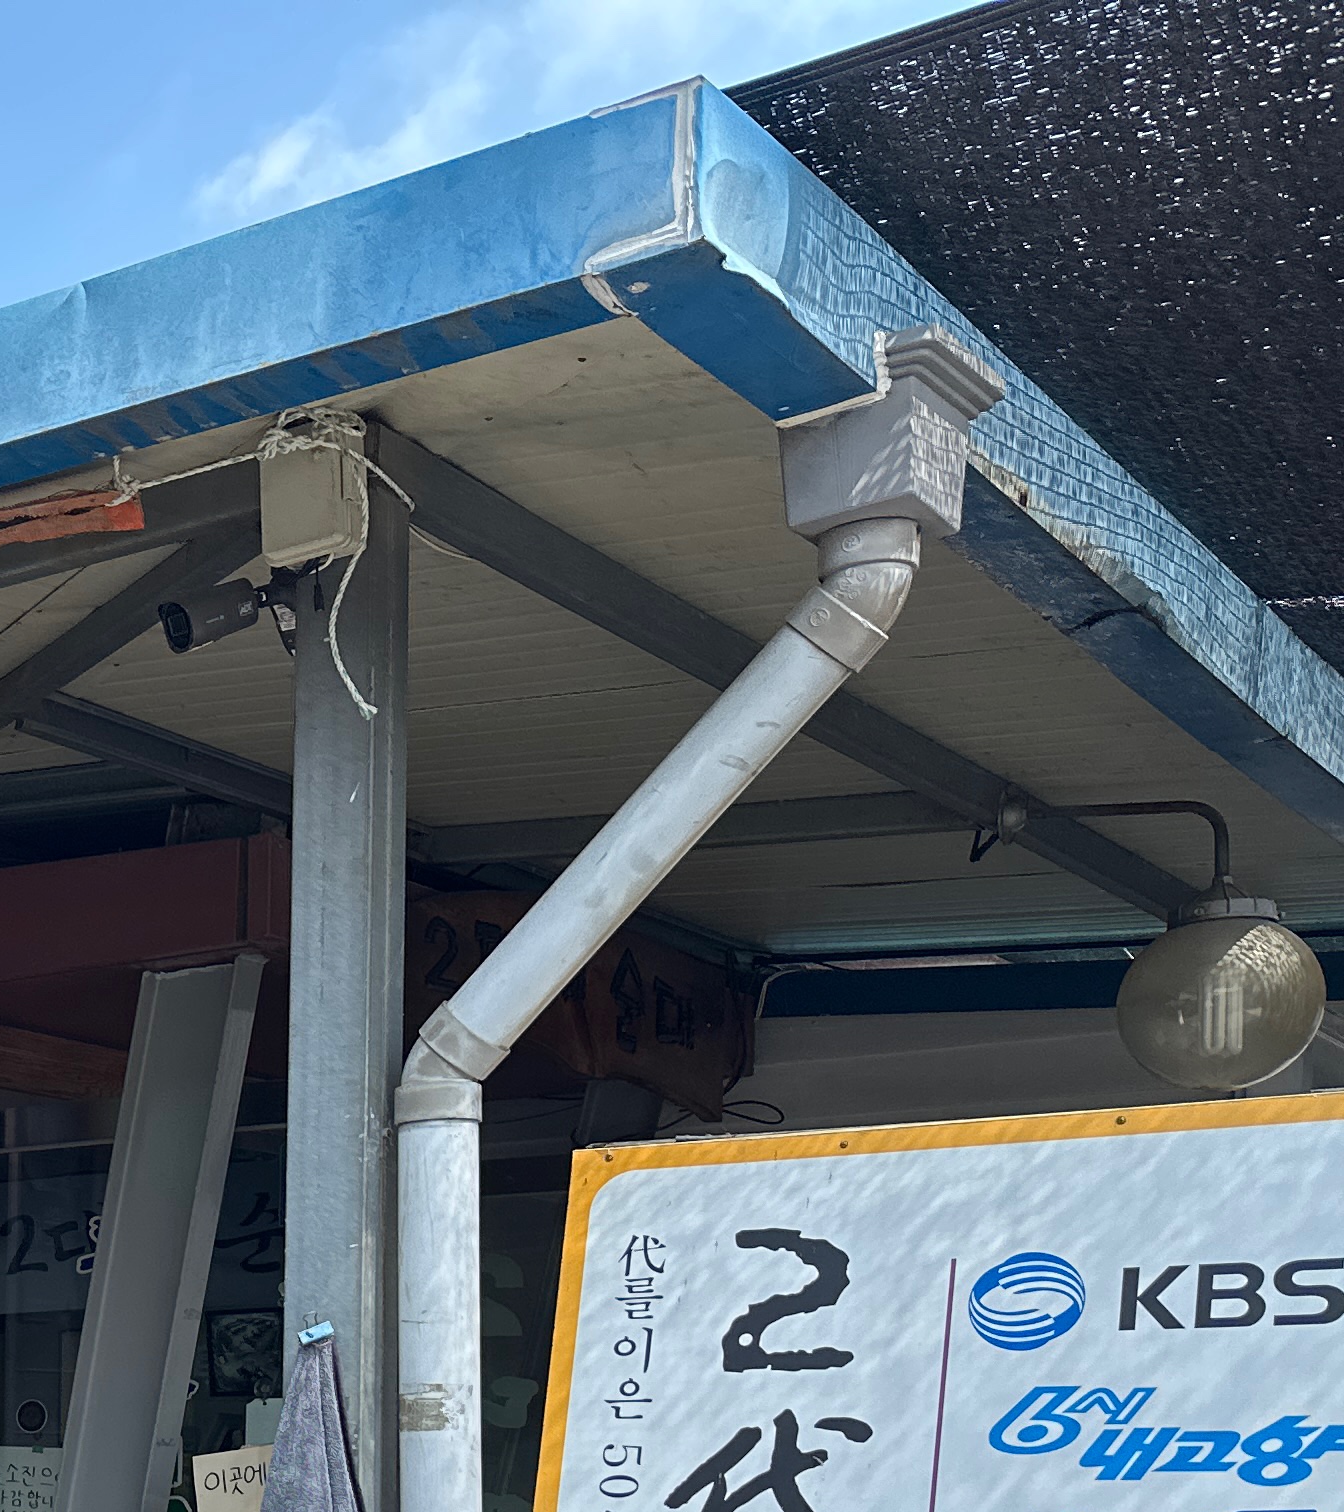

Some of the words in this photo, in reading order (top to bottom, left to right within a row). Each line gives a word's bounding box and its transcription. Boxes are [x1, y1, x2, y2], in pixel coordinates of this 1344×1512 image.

[1118, 1257, 1344, 1331] KBS
[988, 1385, 1159, 1455] 6시
[204, 1461, 267, 1495] 이곳에
